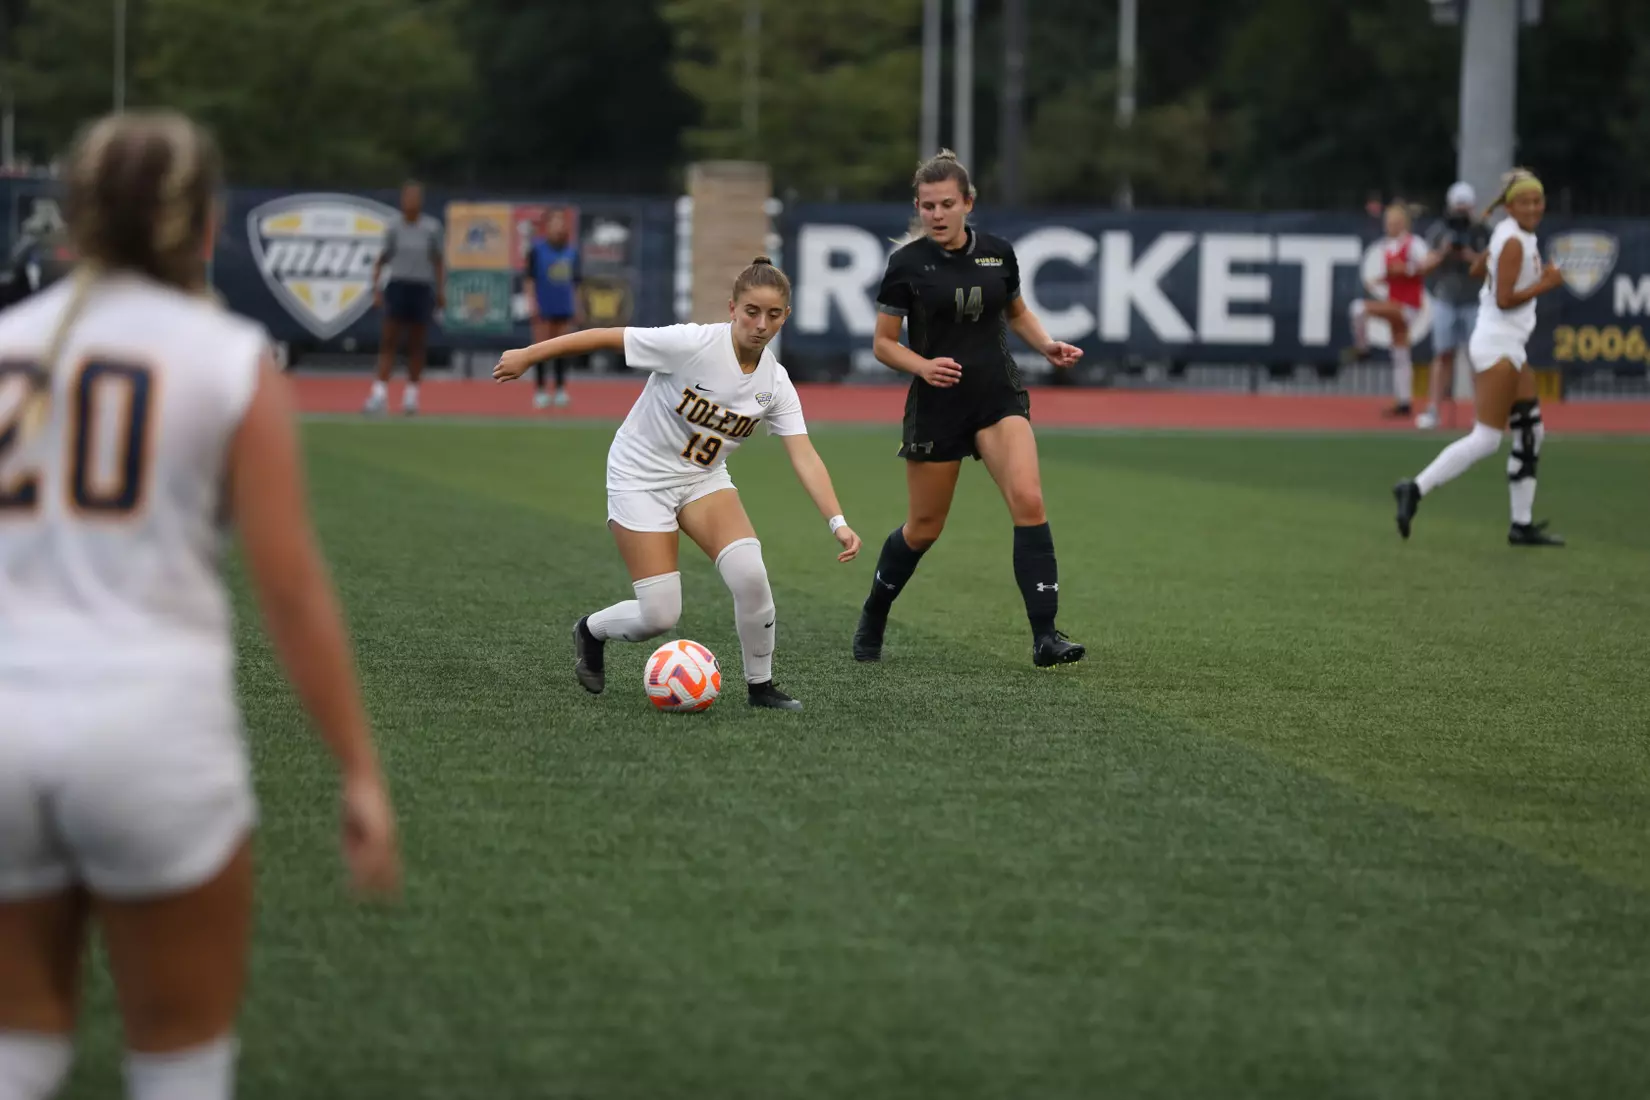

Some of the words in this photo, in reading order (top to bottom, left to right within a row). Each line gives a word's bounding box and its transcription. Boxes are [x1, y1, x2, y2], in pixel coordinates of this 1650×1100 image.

[796, 223, 1432, 347] RCKET
[955, 286, 984, 323] 14
[675, 386, 761, 438] TOLEDO
[681, 432, 723, 467] 19
